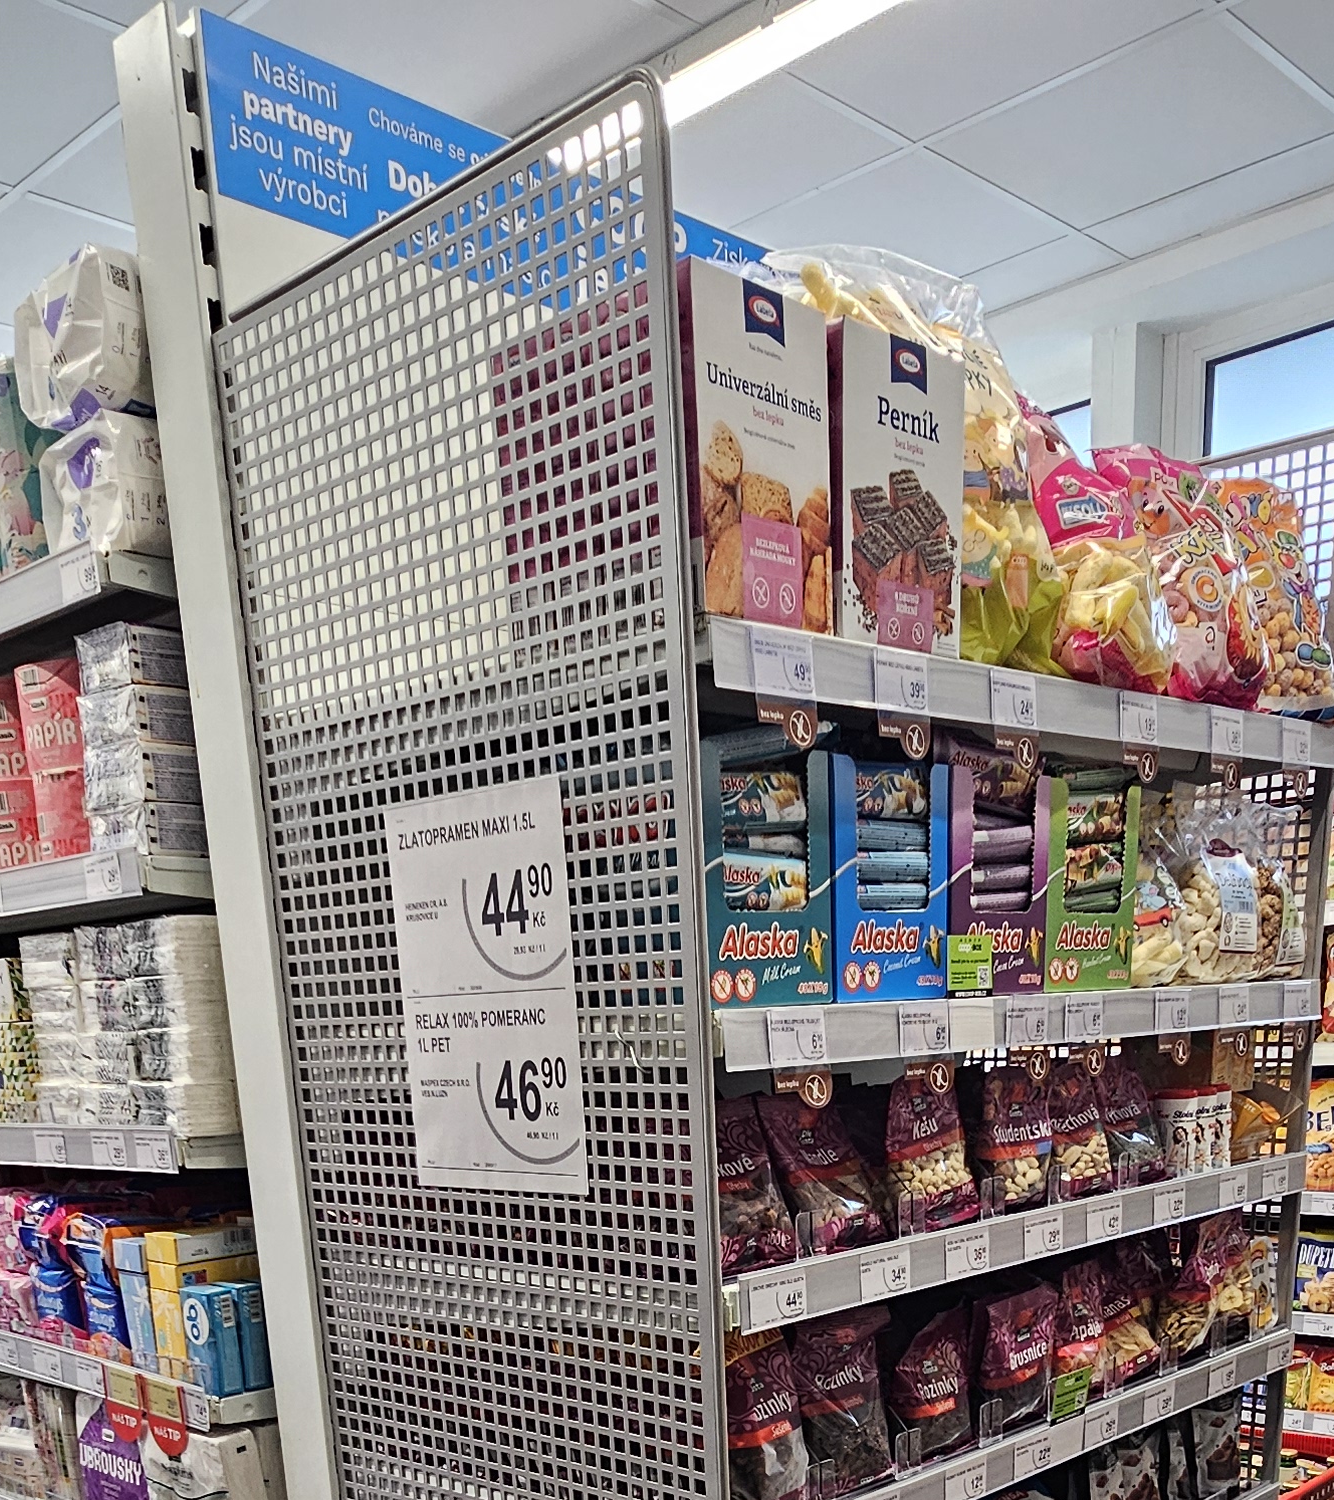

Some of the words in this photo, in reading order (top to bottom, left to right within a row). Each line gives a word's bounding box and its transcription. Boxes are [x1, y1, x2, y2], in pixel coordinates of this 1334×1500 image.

[251, 50, 339, 111] Našimi
[243, 90, 353, 157] partnery
[368, 107, 444, 155] Chováme
[448, 143, 467, 163] se
[229, 114, 284, 162] jsou
[293, 143, 369, 193] místní
[259, 167, 349, 220] výrobci
[705, 361, 789, 410] Univerzální
[790, 398, 822, 423] směs
[877, 395, 940, 444] Perník
[25, 711, 79, 749] PAPÍR
[398, 820, 480, 851] ZLATOPRAMEN
[482, 815, 510, 838] MAXI
[513, 811, 536, 832] 1.5L
[532, 911, 547, 928] Kč
[851, 919, 920, 955] Alaska
[1056, 921, 1112, 951] Alaska
[719, 922, 800, 962] Alaska
[415, 1012, 450, 1030] RELAX
[452, 1011, 479, 1029] 100%
[481, 1008, 546, 1028] POMERANC
[418, 1037, 430, 1053] 1L
[431, 1037, 451, 1053] PET
[545, 1101, 560, 1117] Kč
[913, 1117, 939, 1141] Kešu
[1009, 1341, 1048, 1371] Brusnice
[918, 1375, 960, 1401] Rozinky
[167, 1427, 182, 1442] TIP
[78, 1441, 143, 1486] UBROUSKY
